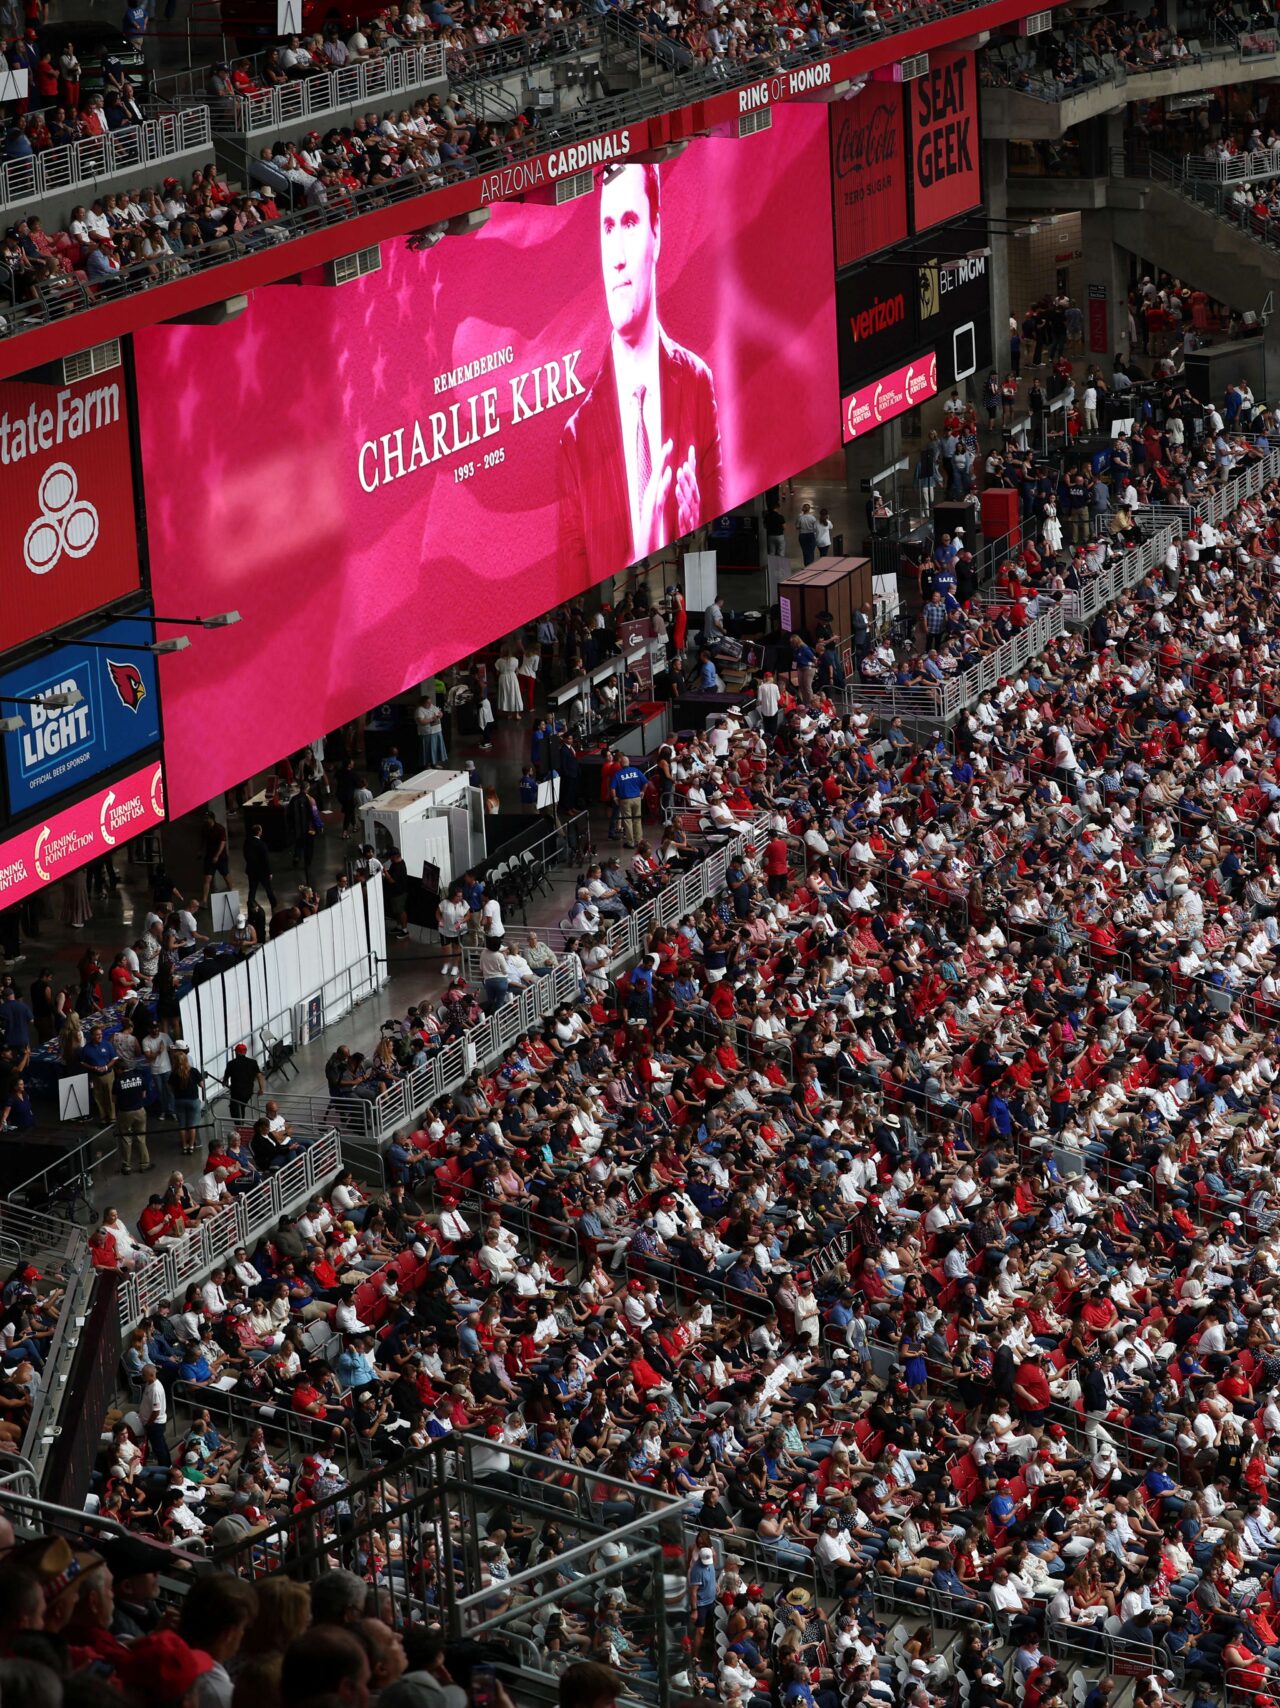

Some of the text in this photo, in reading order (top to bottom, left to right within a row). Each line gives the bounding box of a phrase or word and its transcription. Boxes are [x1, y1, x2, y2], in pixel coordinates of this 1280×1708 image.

[739, 63, 830, 112] RING OF HONOR
[918, 56, 967, 127] SEAT
[480, 130, 630, 204] ARIZONA CARDINALS
[917, 116, 973, 188] GEEK
[844, 176, 892, 206] ZERO SUGAR
[850, 294, 904, 343] verizon
[433, 346, 514, 394] REMEMBERING
[358, 350, 586, 493] CHARLIE KIRK
[454, 462, 474, 484] 1993
[484, 448, 506, 470] 2025
[30, 678, 78, 728] BUD
[24, 705, 88, 767] LIGHT
[30, 752, 90, 788] OFFICIAL BEER SPONSOR
[109, 795, 140, 820] TURNING
[110, 804, 144, 830] POINT USA
[43, 830, 76, 855] TURNING
[45, 831, 93, 865] POINT ACTION
[0, 858, 23, 880] RNING
[13, 867, 27, 883] USA
